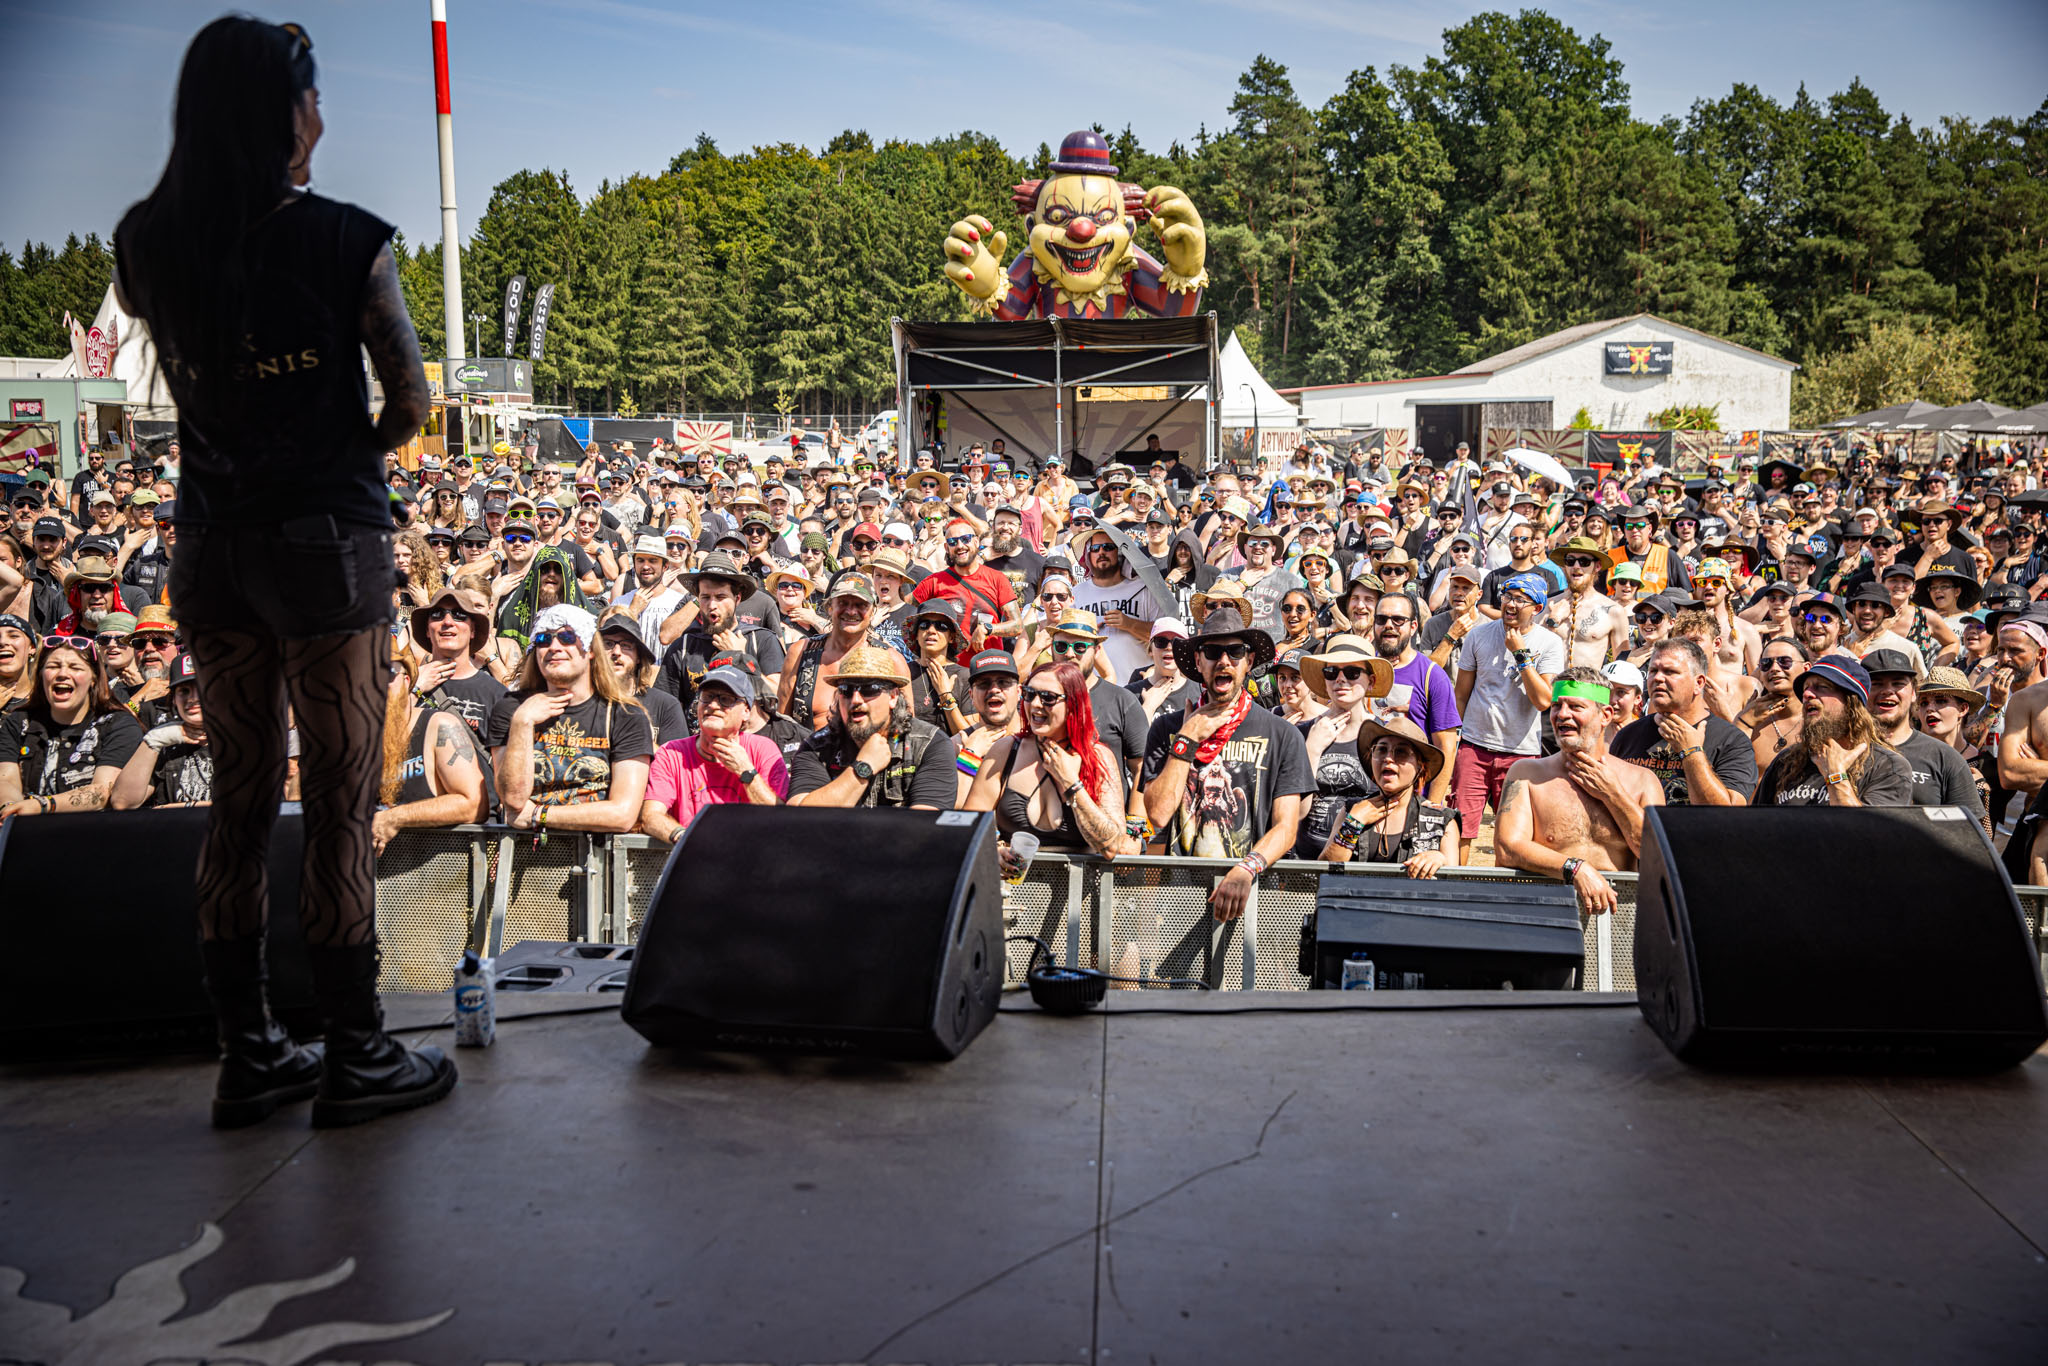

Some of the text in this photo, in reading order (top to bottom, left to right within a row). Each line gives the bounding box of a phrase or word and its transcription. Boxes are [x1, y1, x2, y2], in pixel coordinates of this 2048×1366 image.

[505, 280, 521, 355] DÖNER
[532, 289, 549, 359] LAHMACUN
[1260, 431, 1301, 453] ARTWORK
[550, 745, 577, 757] 2025
[567, 736, 609, 749] BREEZ
[1221, 735, 1269, 770] HWANZ
[1624, 757, 1683, 770] UMMER BR
[1655, 770, 1673, 778] 025
[1776, 784, 1830, 804] motörhe
